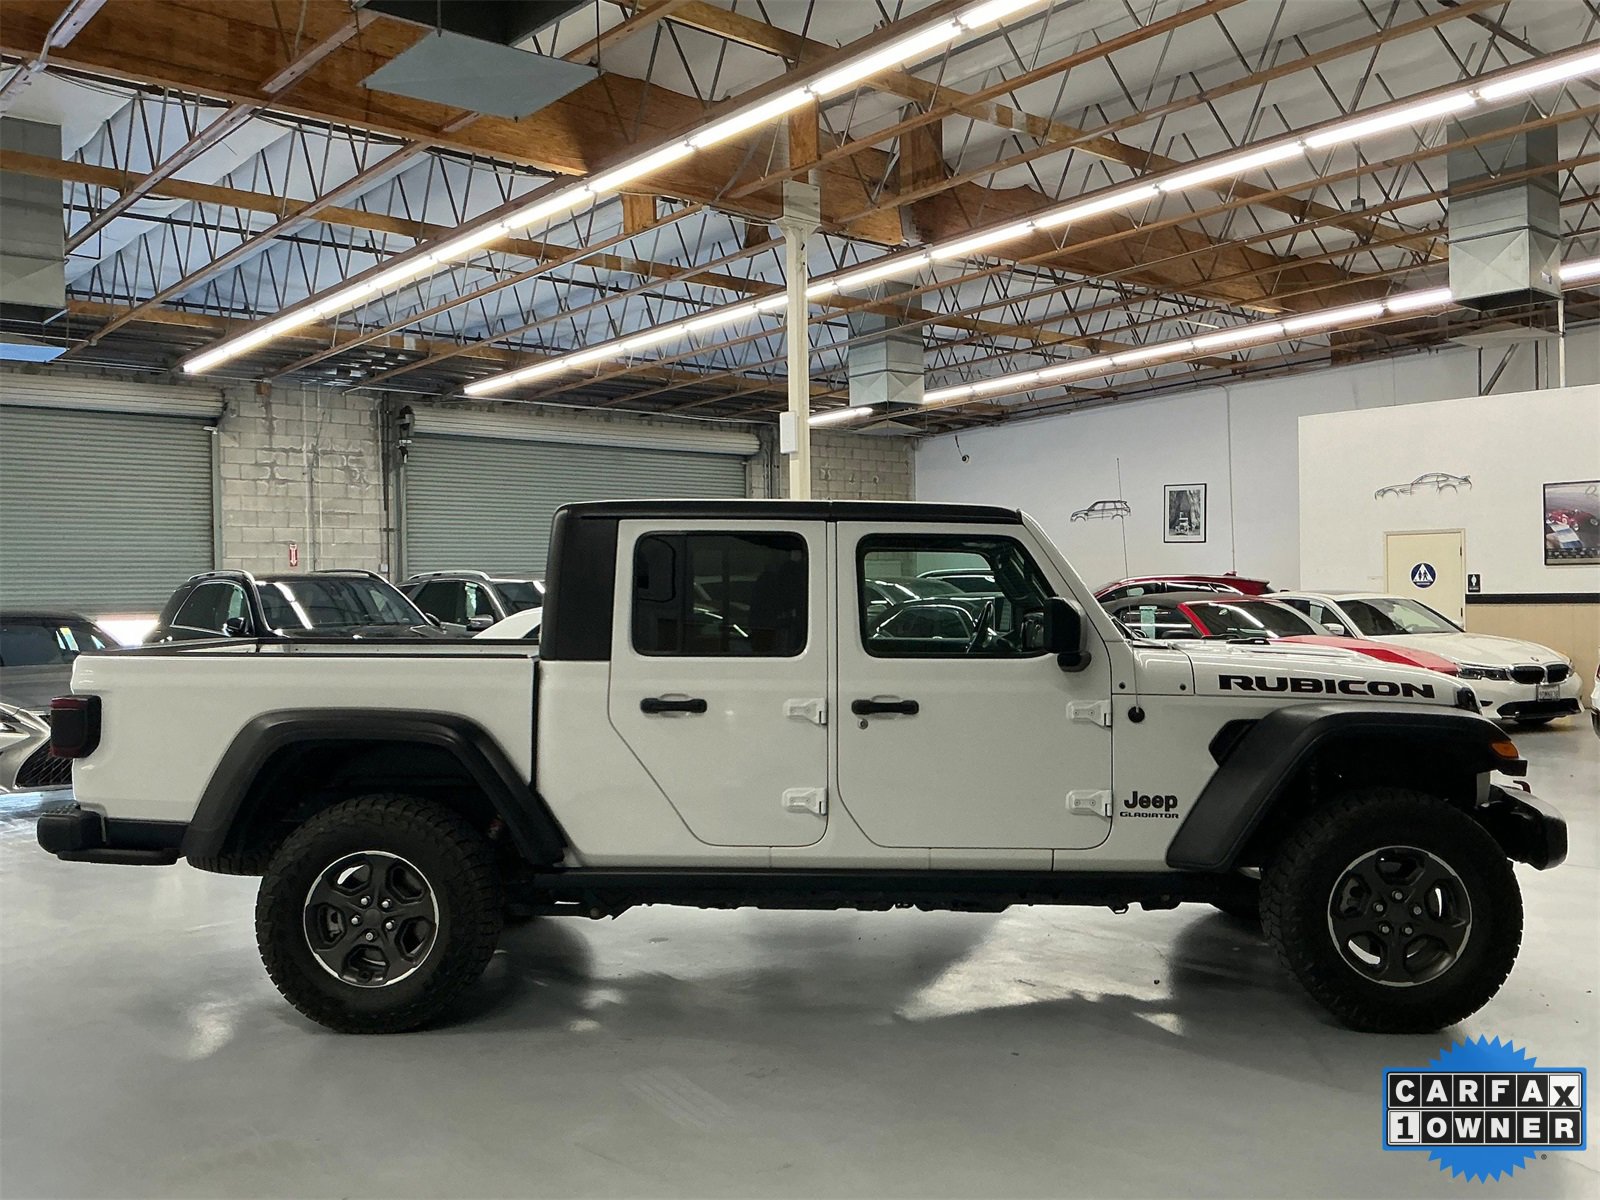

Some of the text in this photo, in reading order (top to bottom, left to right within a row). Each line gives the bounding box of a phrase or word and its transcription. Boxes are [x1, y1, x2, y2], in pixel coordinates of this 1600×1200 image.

[1218, 674, 1435, 699] RUBICON
[1123, 791, 1178, 812] Jeep
[1119, 811, 1179, 819] GLADIATOR
